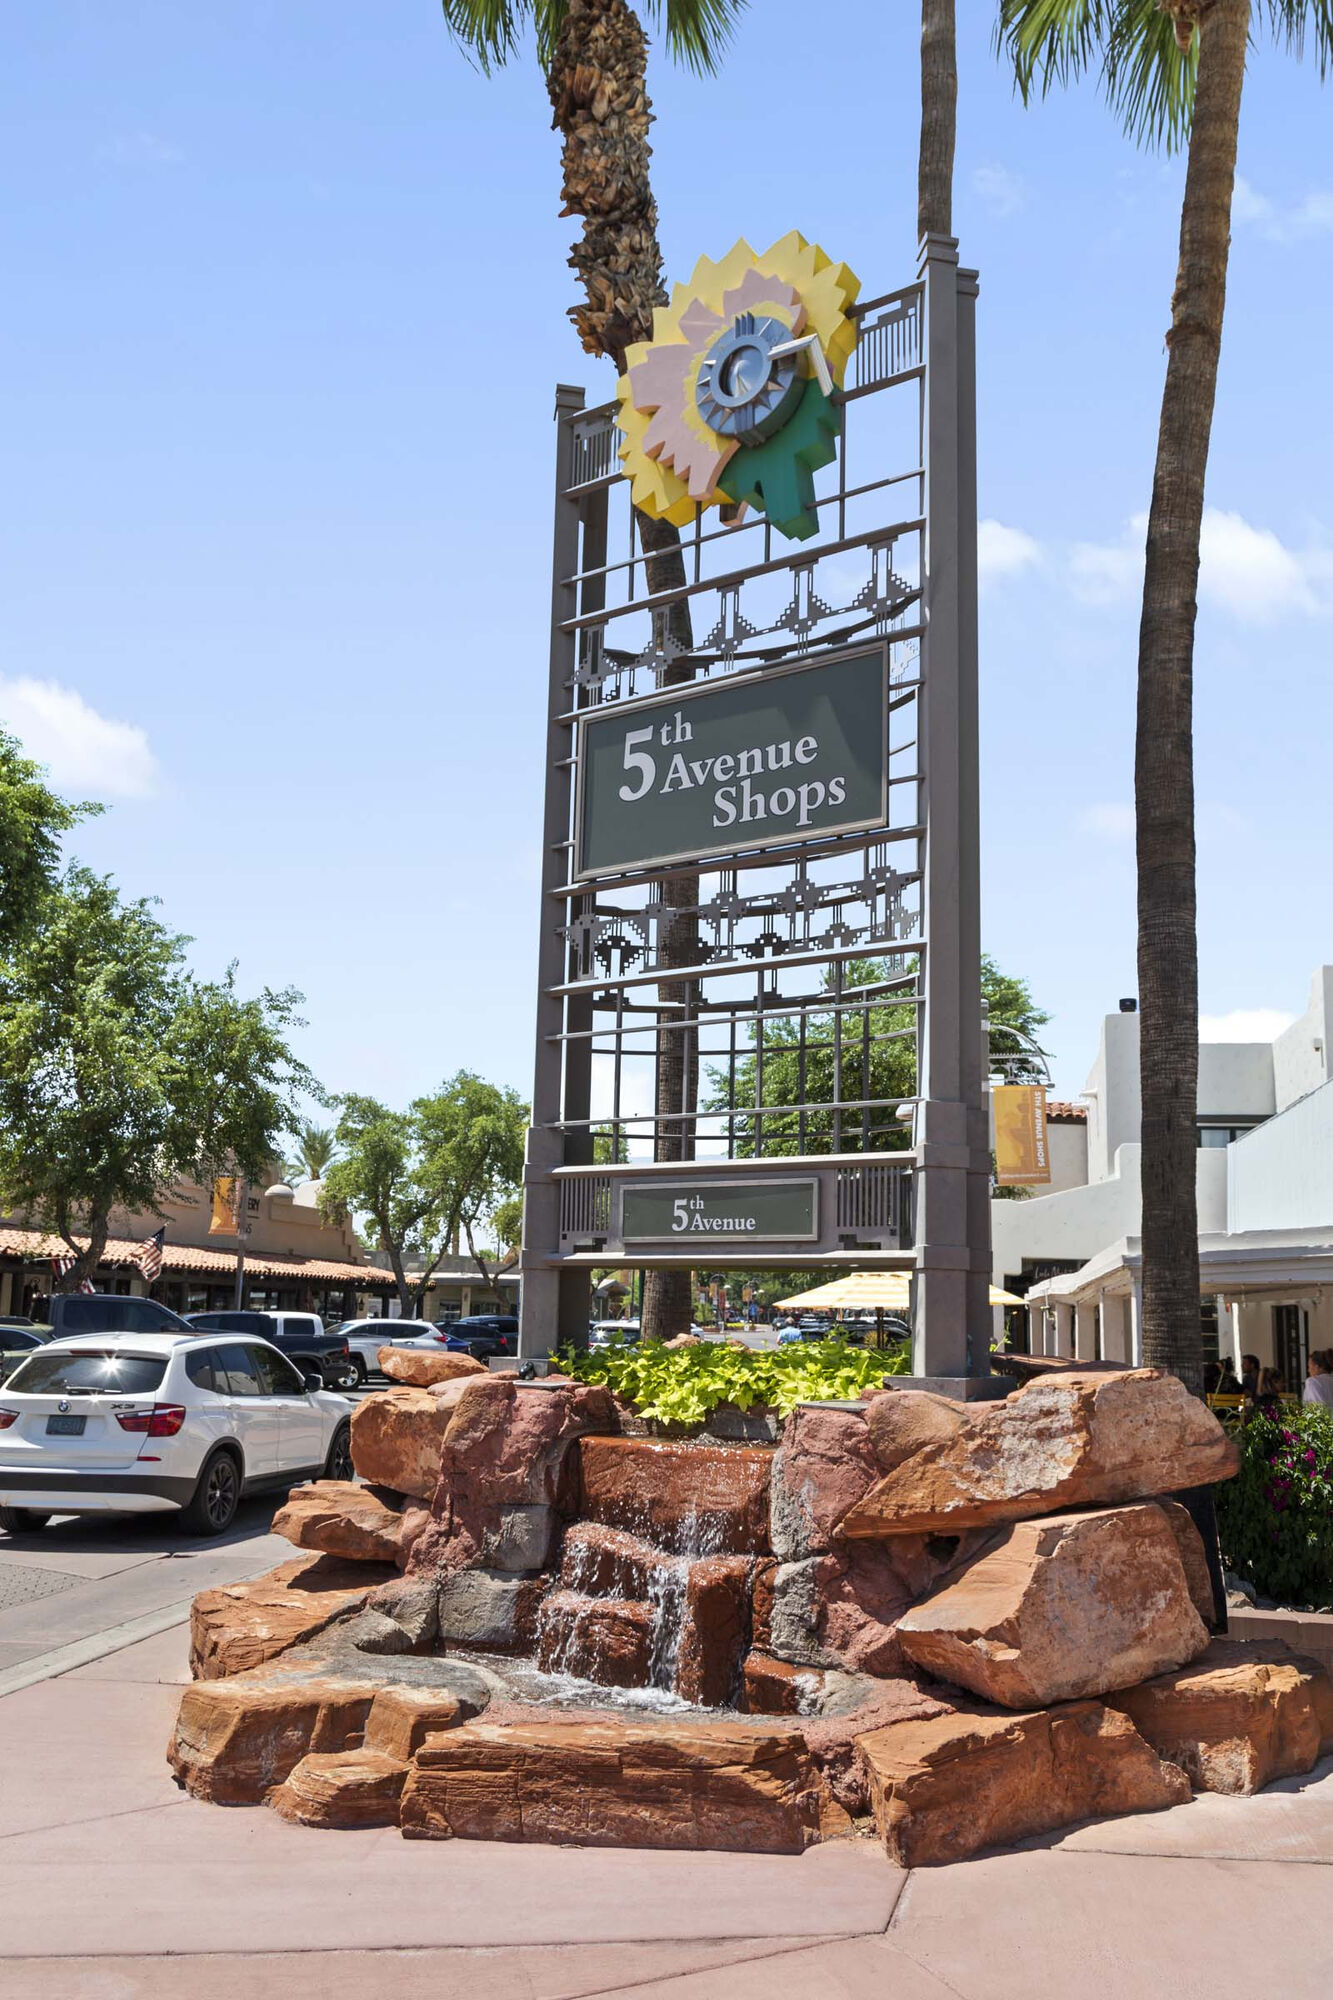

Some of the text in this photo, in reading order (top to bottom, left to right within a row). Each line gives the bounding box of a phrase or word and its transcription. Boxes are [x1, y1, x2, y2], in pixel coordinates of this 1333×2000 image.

[618, 711, 818, 801] 5th Avenue
[712, 776, 846, 827] Shops
[1034, 1091, 1045, 1168] 5TH AVENUE SHOPS
[671, 1194, 757, 1231] 5th Avenue
